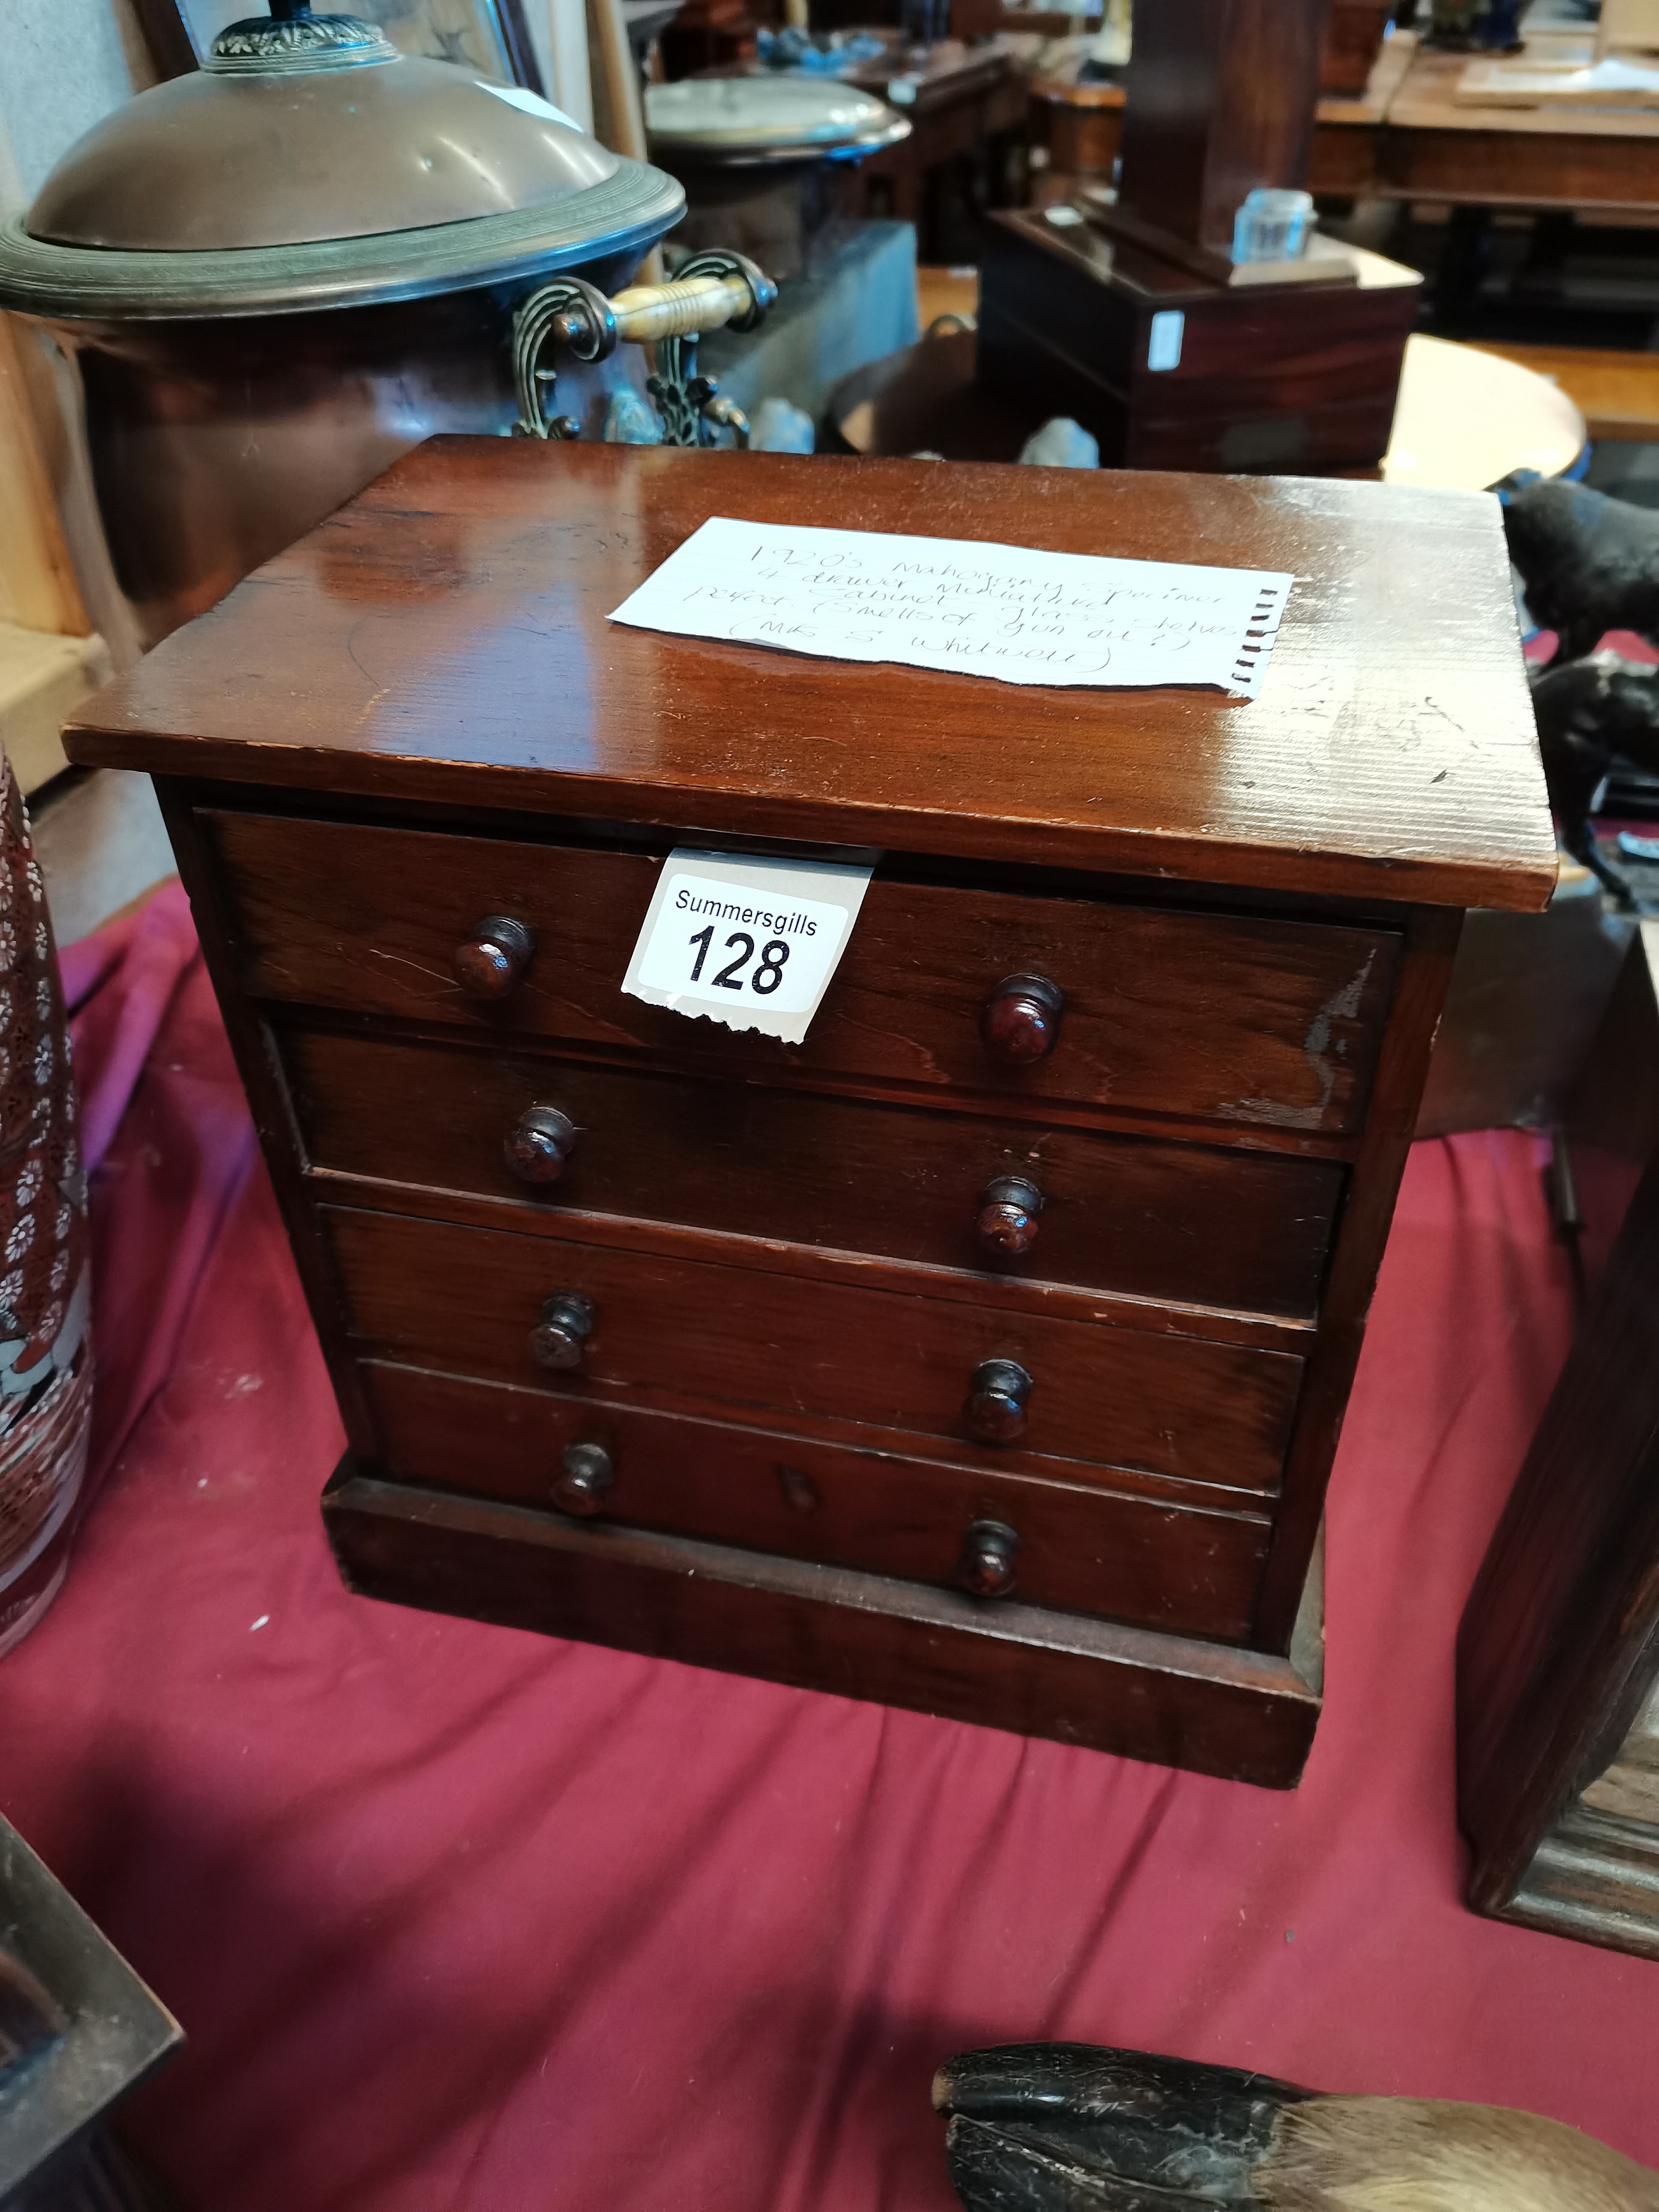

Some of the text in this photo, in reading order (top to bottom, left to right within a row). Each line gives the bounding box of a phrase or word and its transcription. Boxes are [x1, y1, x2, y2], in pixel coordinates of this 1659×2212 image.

[751, 545, 862, 569] 1920's
[757, 567, 787, 579] 4
[802, 571, 911, 589] drawer
[845, 630, 885, 643] S
[941, 612, 978, 626] of
[997, 622, 1065, 637] gun
[675, 890, 817, 936] Summersgills
[688, 925, 790, 995] 128
